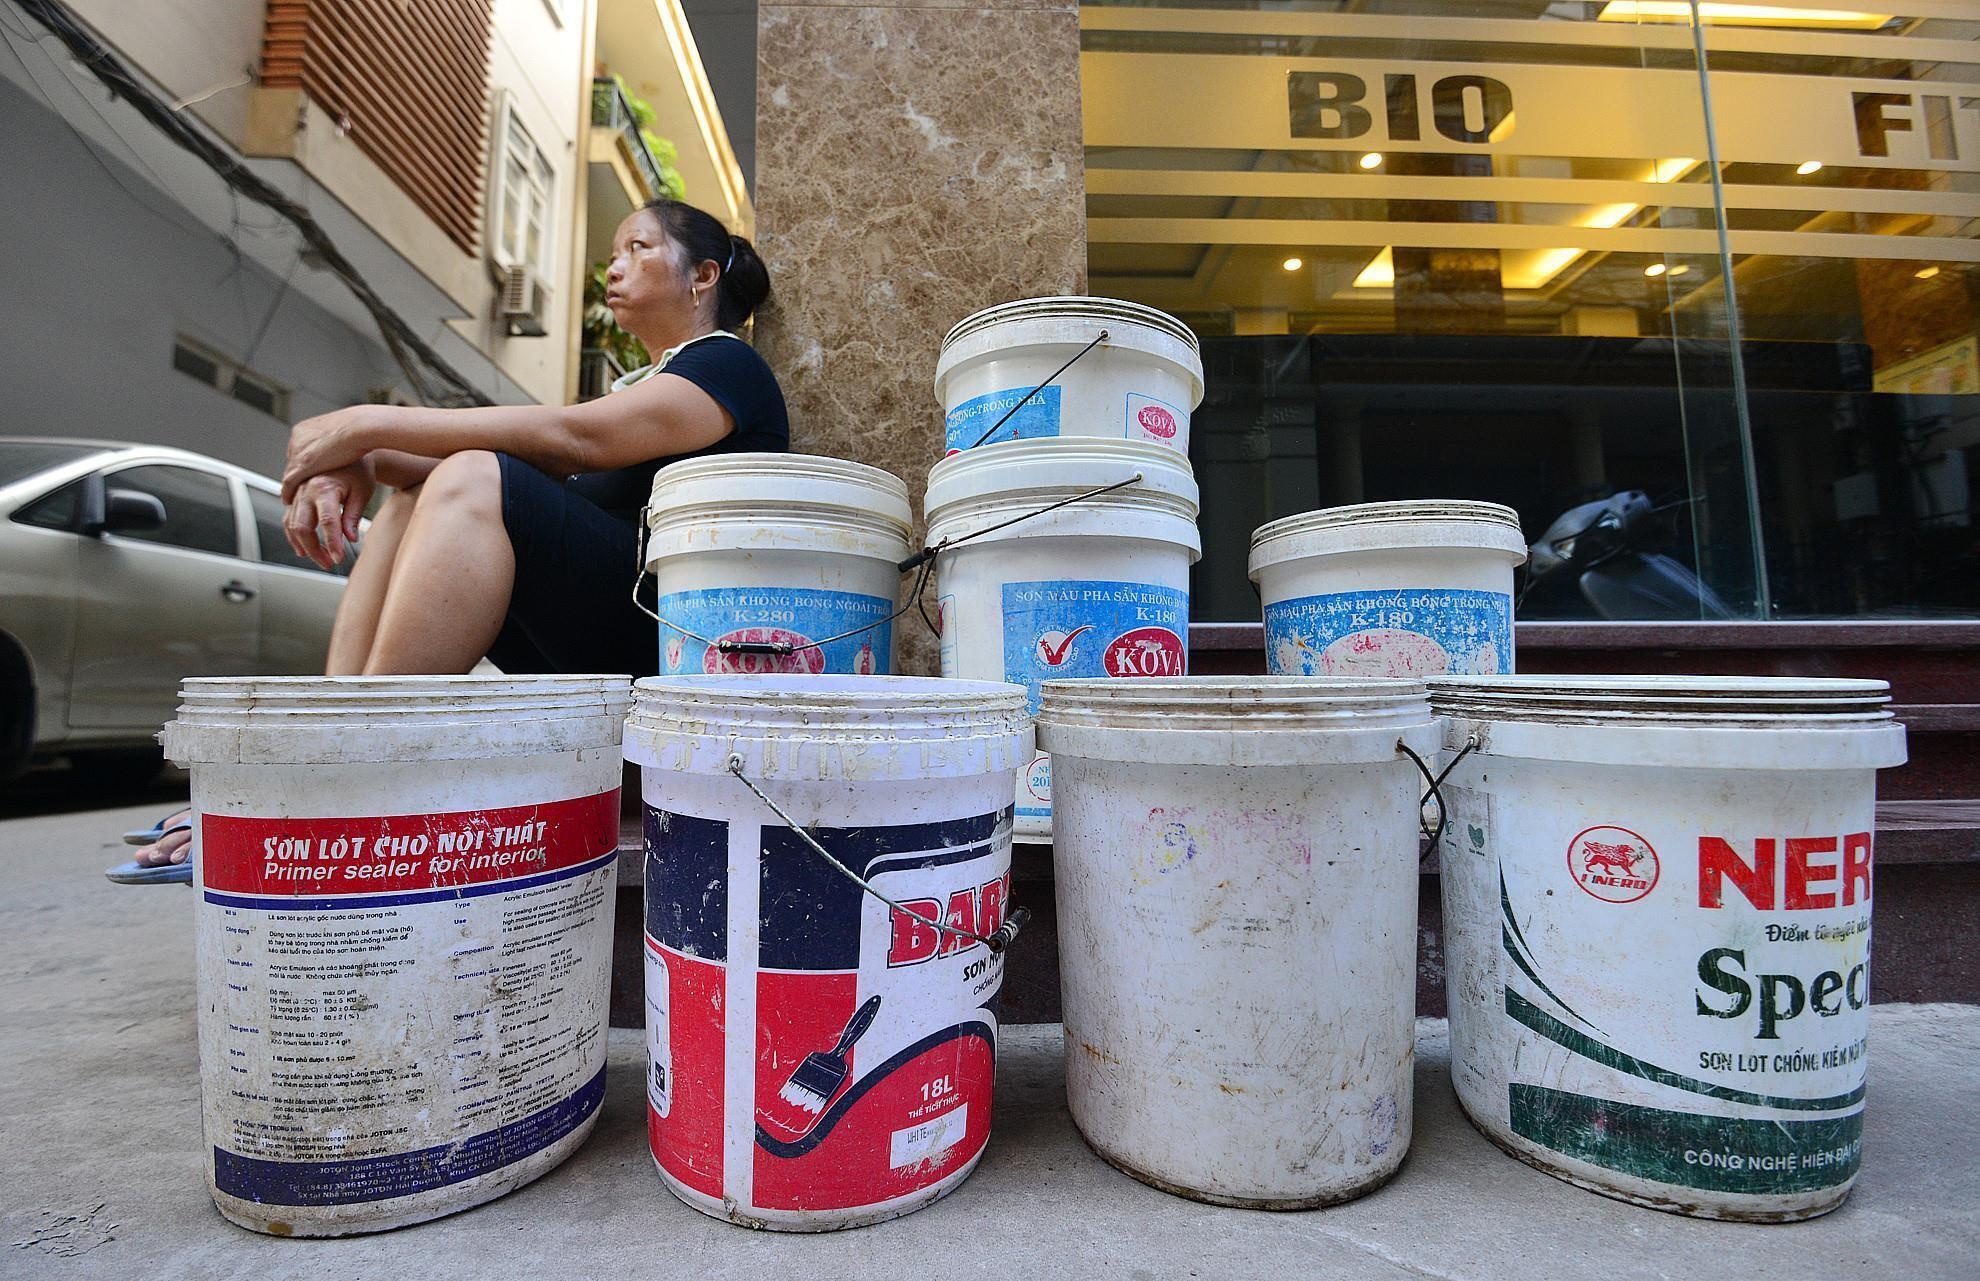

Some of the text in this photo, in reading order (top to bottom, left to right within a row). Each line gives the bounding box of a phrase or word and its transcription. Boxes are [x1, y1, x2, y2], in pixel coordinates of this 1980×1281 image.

[1287, 71, 1516, 144] BIO
[1142, 411, 1175, 434] KOVA
[1083, 590, 1111, 601] PHA
[735, 609, 795, 622] K-280
[1135, 606, 1177, 624] K-180
[1348, 610, 1414, 627] K-180
[1116, 647, 1182, 676] KOVA
[263, 816, 548, 860] SƠN LÓT CHO NỘI THẤT
[263, 846, 547, 880] Primer sealer for interior
[1764, 921, 1810, 943] Điểm
[453, 944, 495, 957] Composition
[920, 1074, 954, 1101] 18L
[907, 1104, 924, 1119] THỂ
[319, 1166, 349, 1176] JOTON
[1684, 1149, 1744, 1170] CÔNG
[1748, 1152, 1798, 1174] NGHỆ
